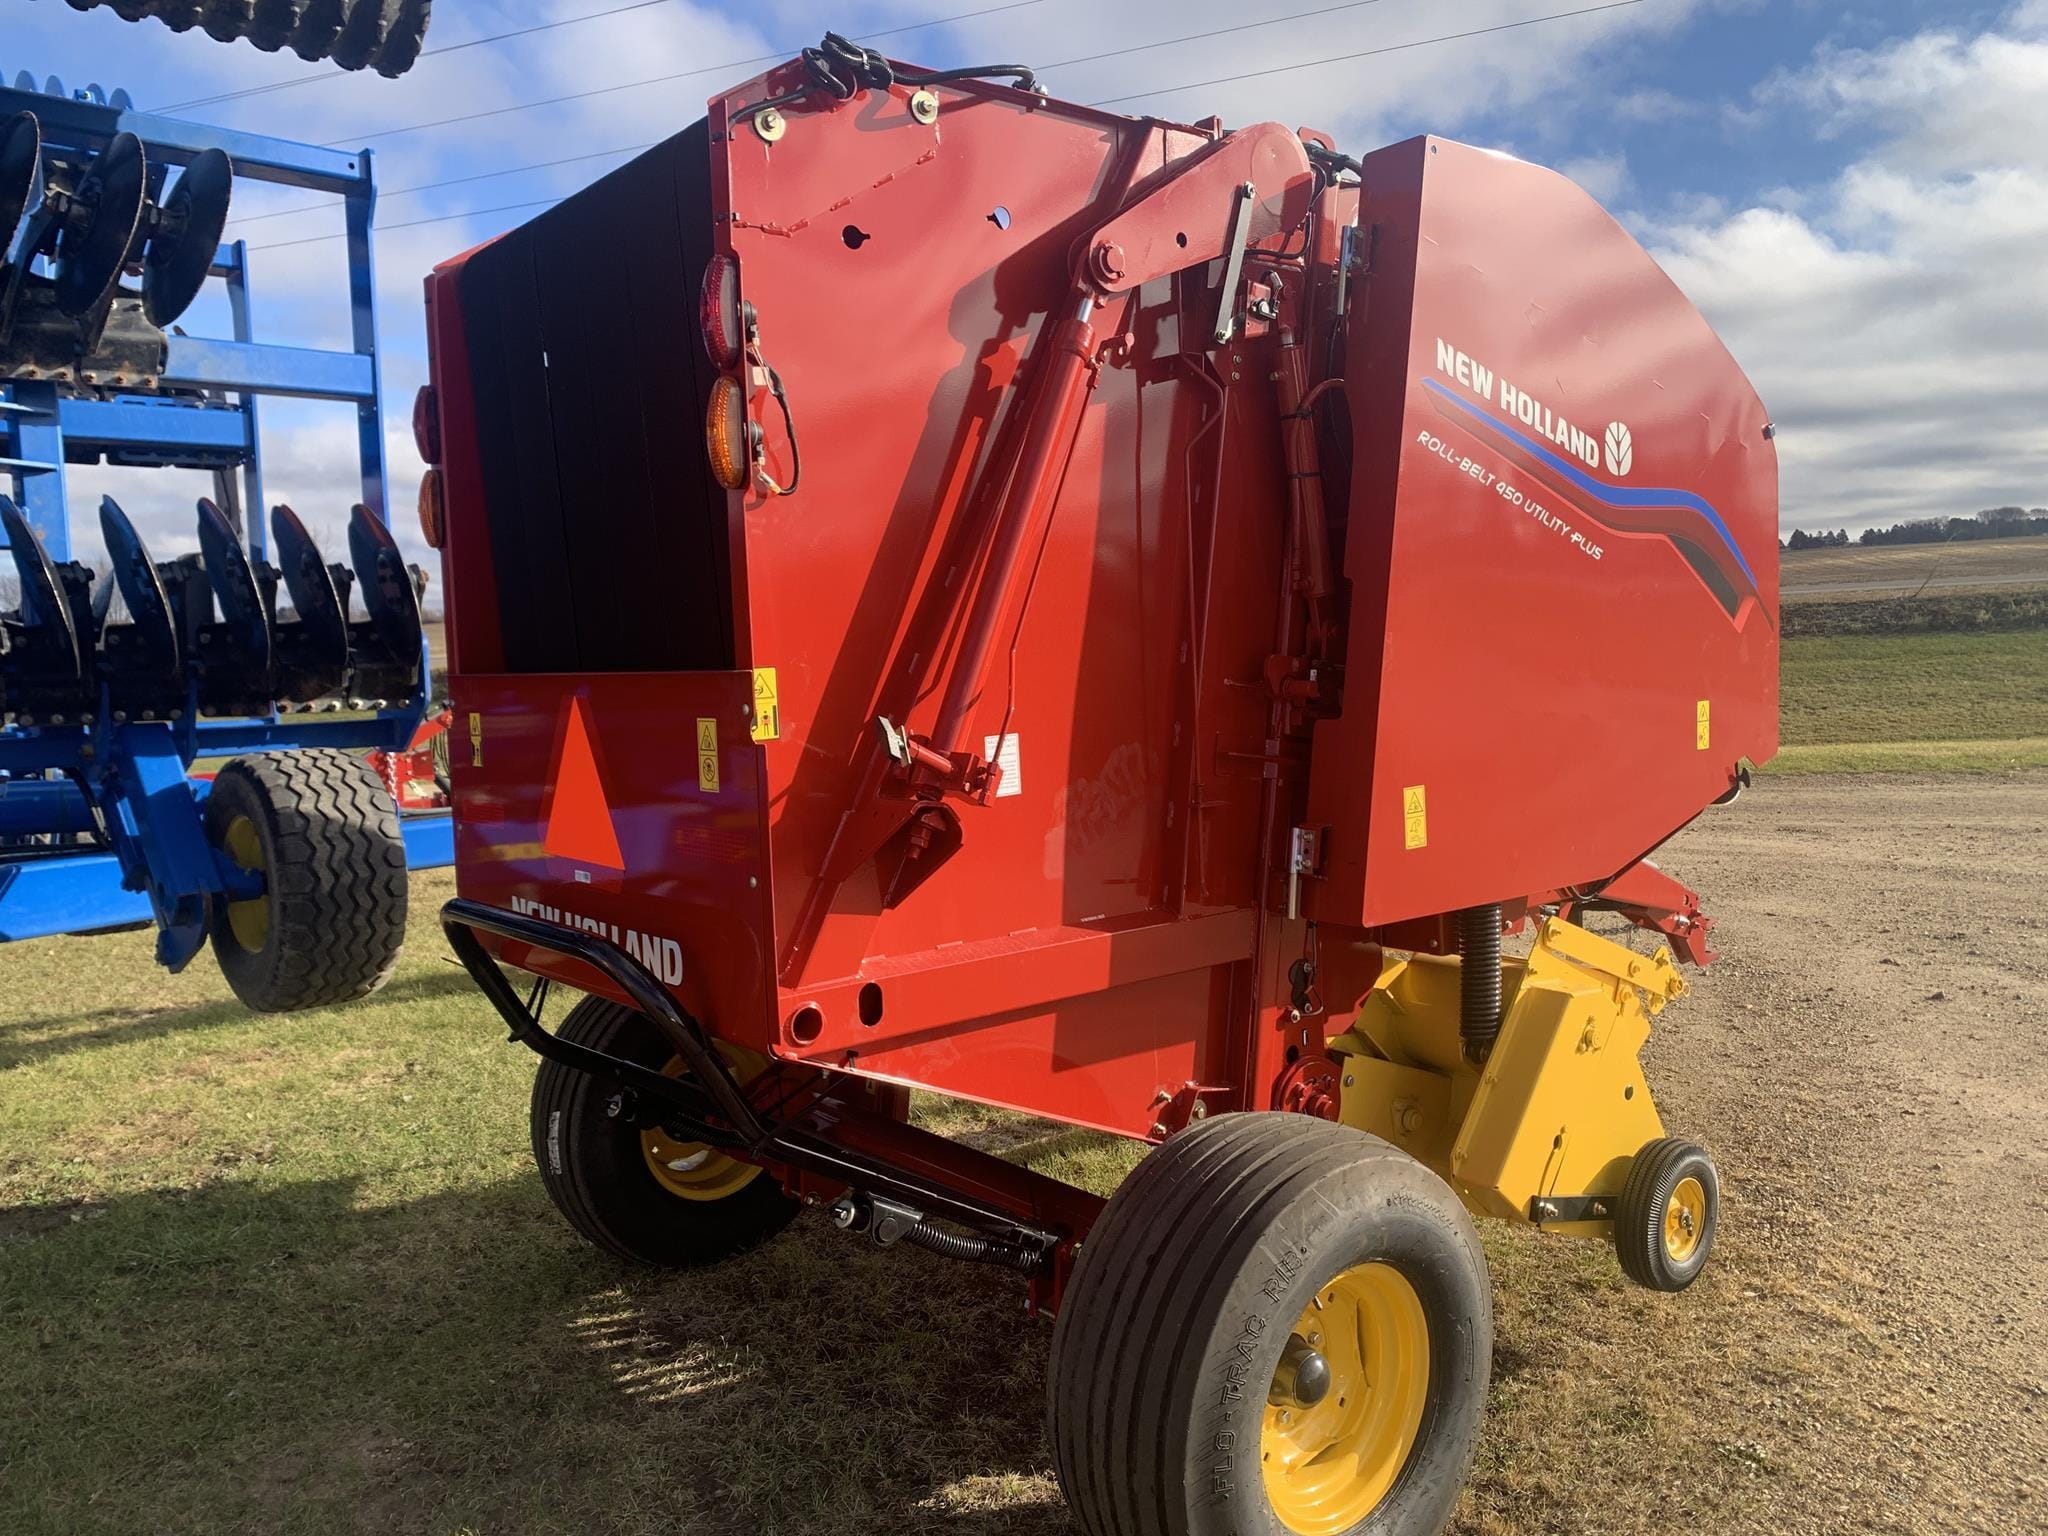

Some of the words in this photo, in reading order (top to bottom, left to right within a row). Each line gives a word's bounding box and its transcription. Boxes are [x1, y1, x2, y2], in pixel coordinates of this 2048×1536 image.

[1436, 336, 1494, 400] NEW
[1500, 377, 1600, 469] HOLLAND
[1416, 429, 1497, 487] ROLL-BELT
[1495, 481, 1524, 506] 450
[1523, 498, 1572, 537] UTILITY
[1263, 1250, 1303, 1304] RIB
